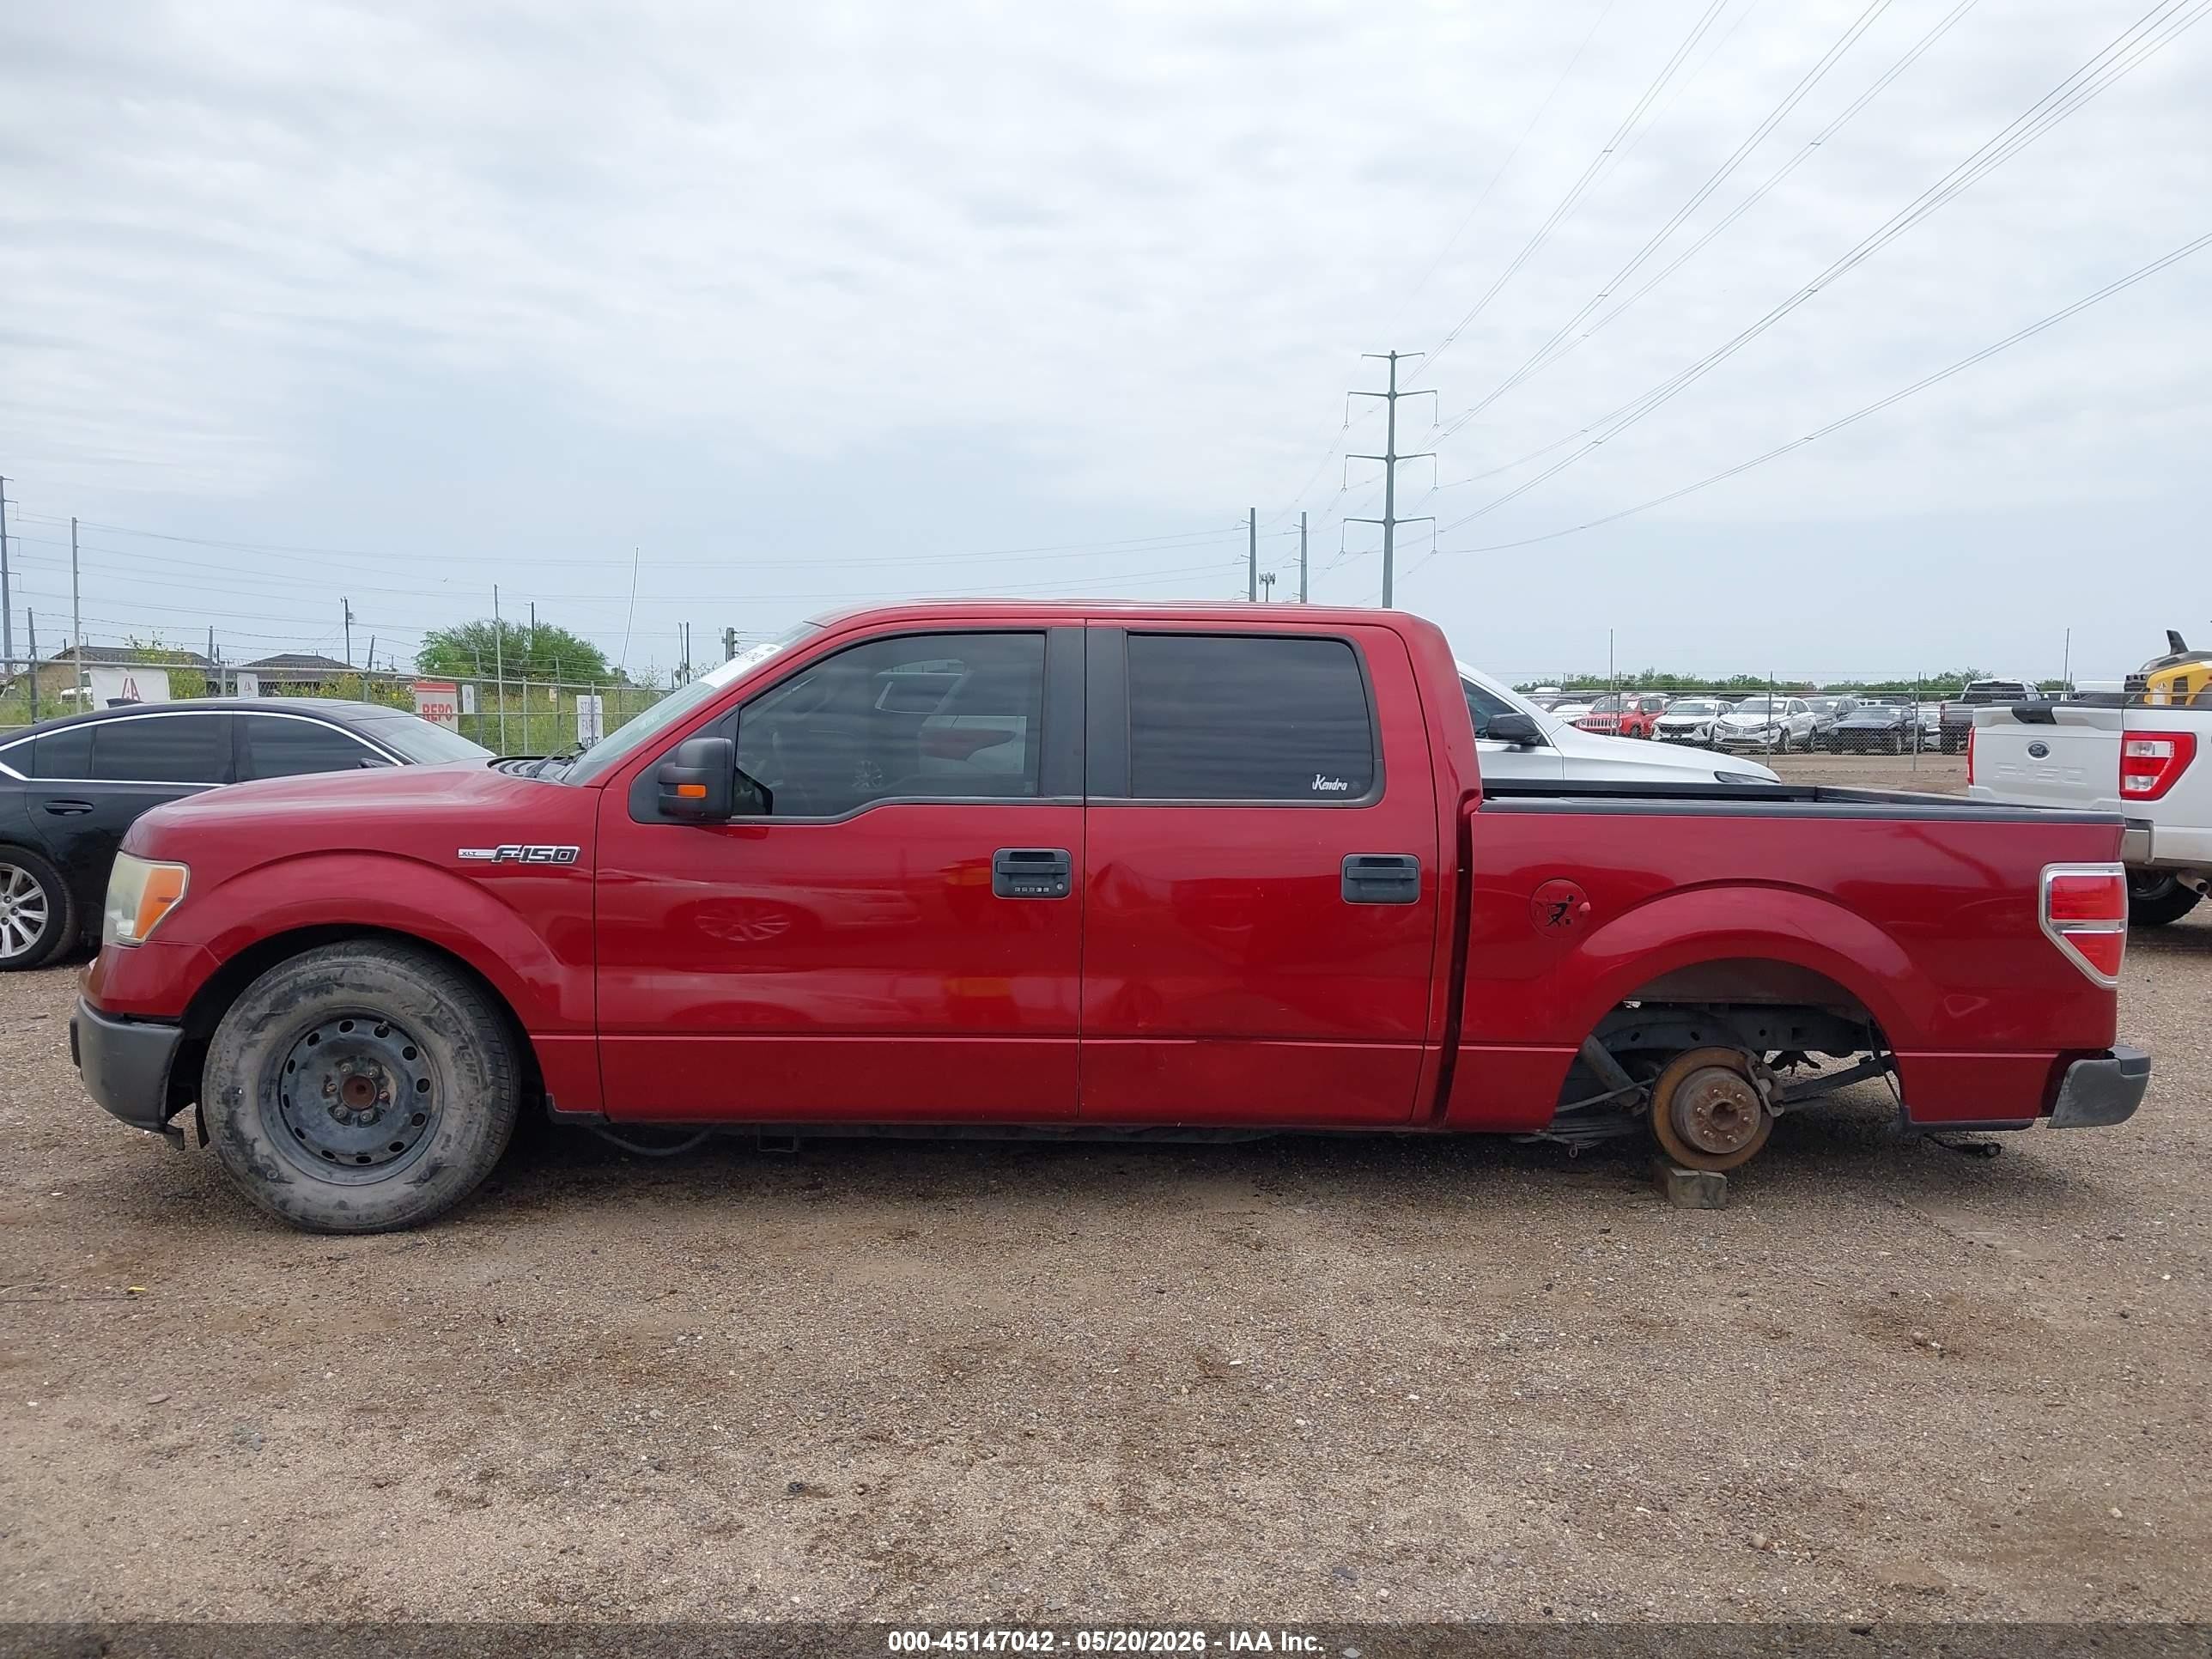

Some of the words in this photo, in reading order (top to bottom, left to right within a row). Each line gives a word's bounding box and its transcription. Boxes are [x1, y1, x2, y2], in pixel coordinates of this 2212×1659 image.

[422, 703, 453, 721] REPO
[580, 701, 599, 714] STAE
[1311, 774, 1348, 791] Kendra
[490, 844, 581, 864] F-150
